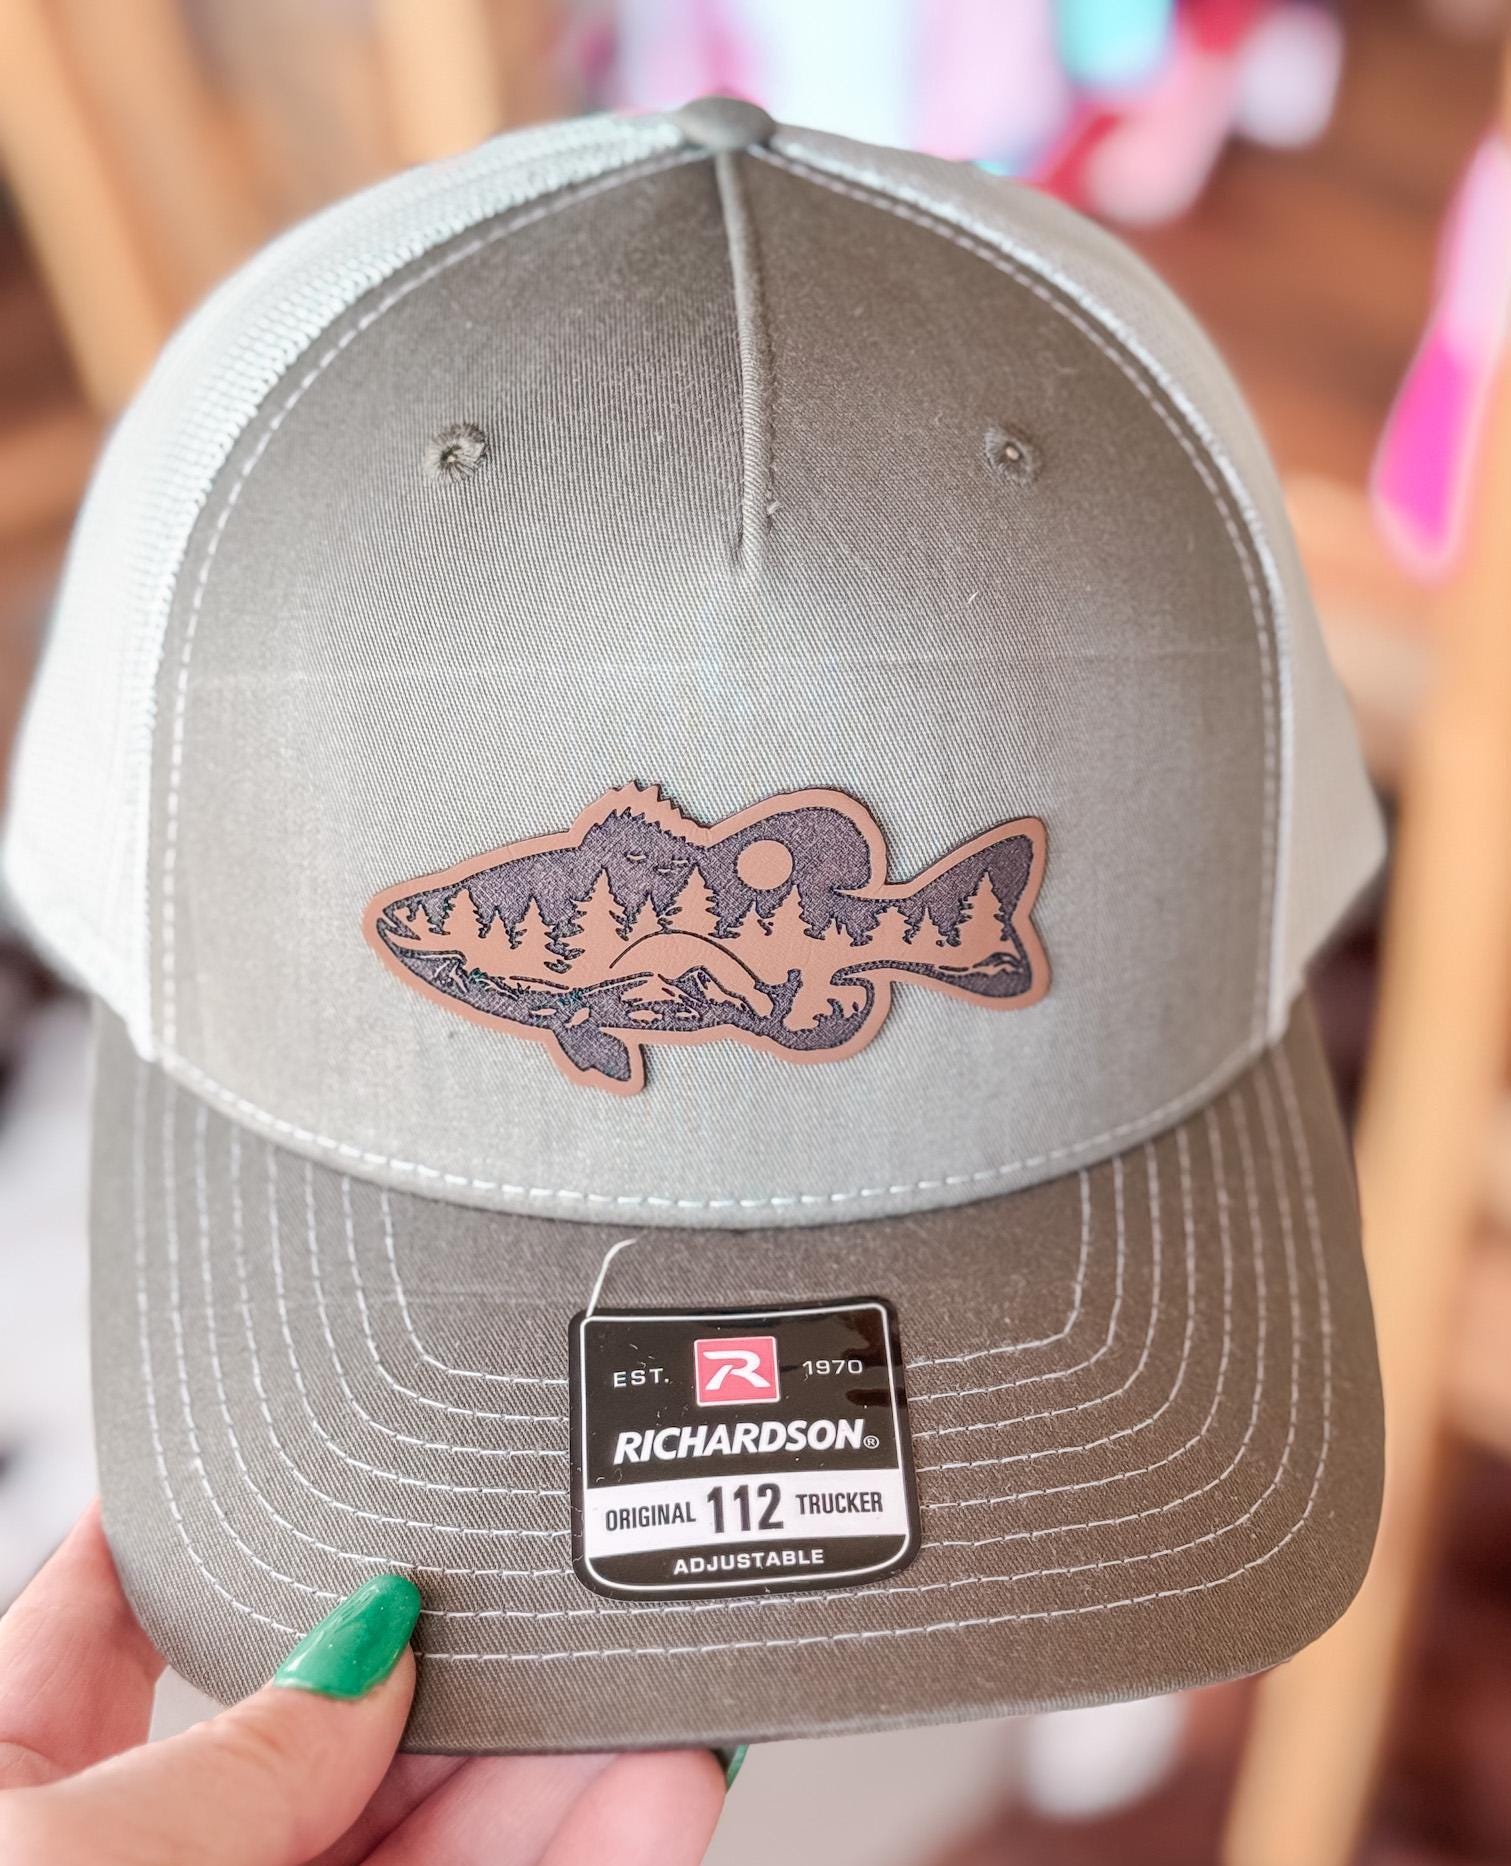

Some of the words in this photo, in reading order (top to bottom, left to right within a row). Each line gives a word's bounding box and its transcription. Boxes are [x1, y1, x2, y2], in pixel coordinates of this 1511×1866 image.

[613, 1368, 670, 1388] EST.
[703, 1350, 771, 1391] R
[802, 1359, 863, 1375] 1970
[605, 1501, 696, 1532] ORIGINAL
[706, 1482, 784, 1534] 112
[795, 1491, 883, 1516] TRUCKER
[673, 1549, 824, 1576] ADJUSTABLE
